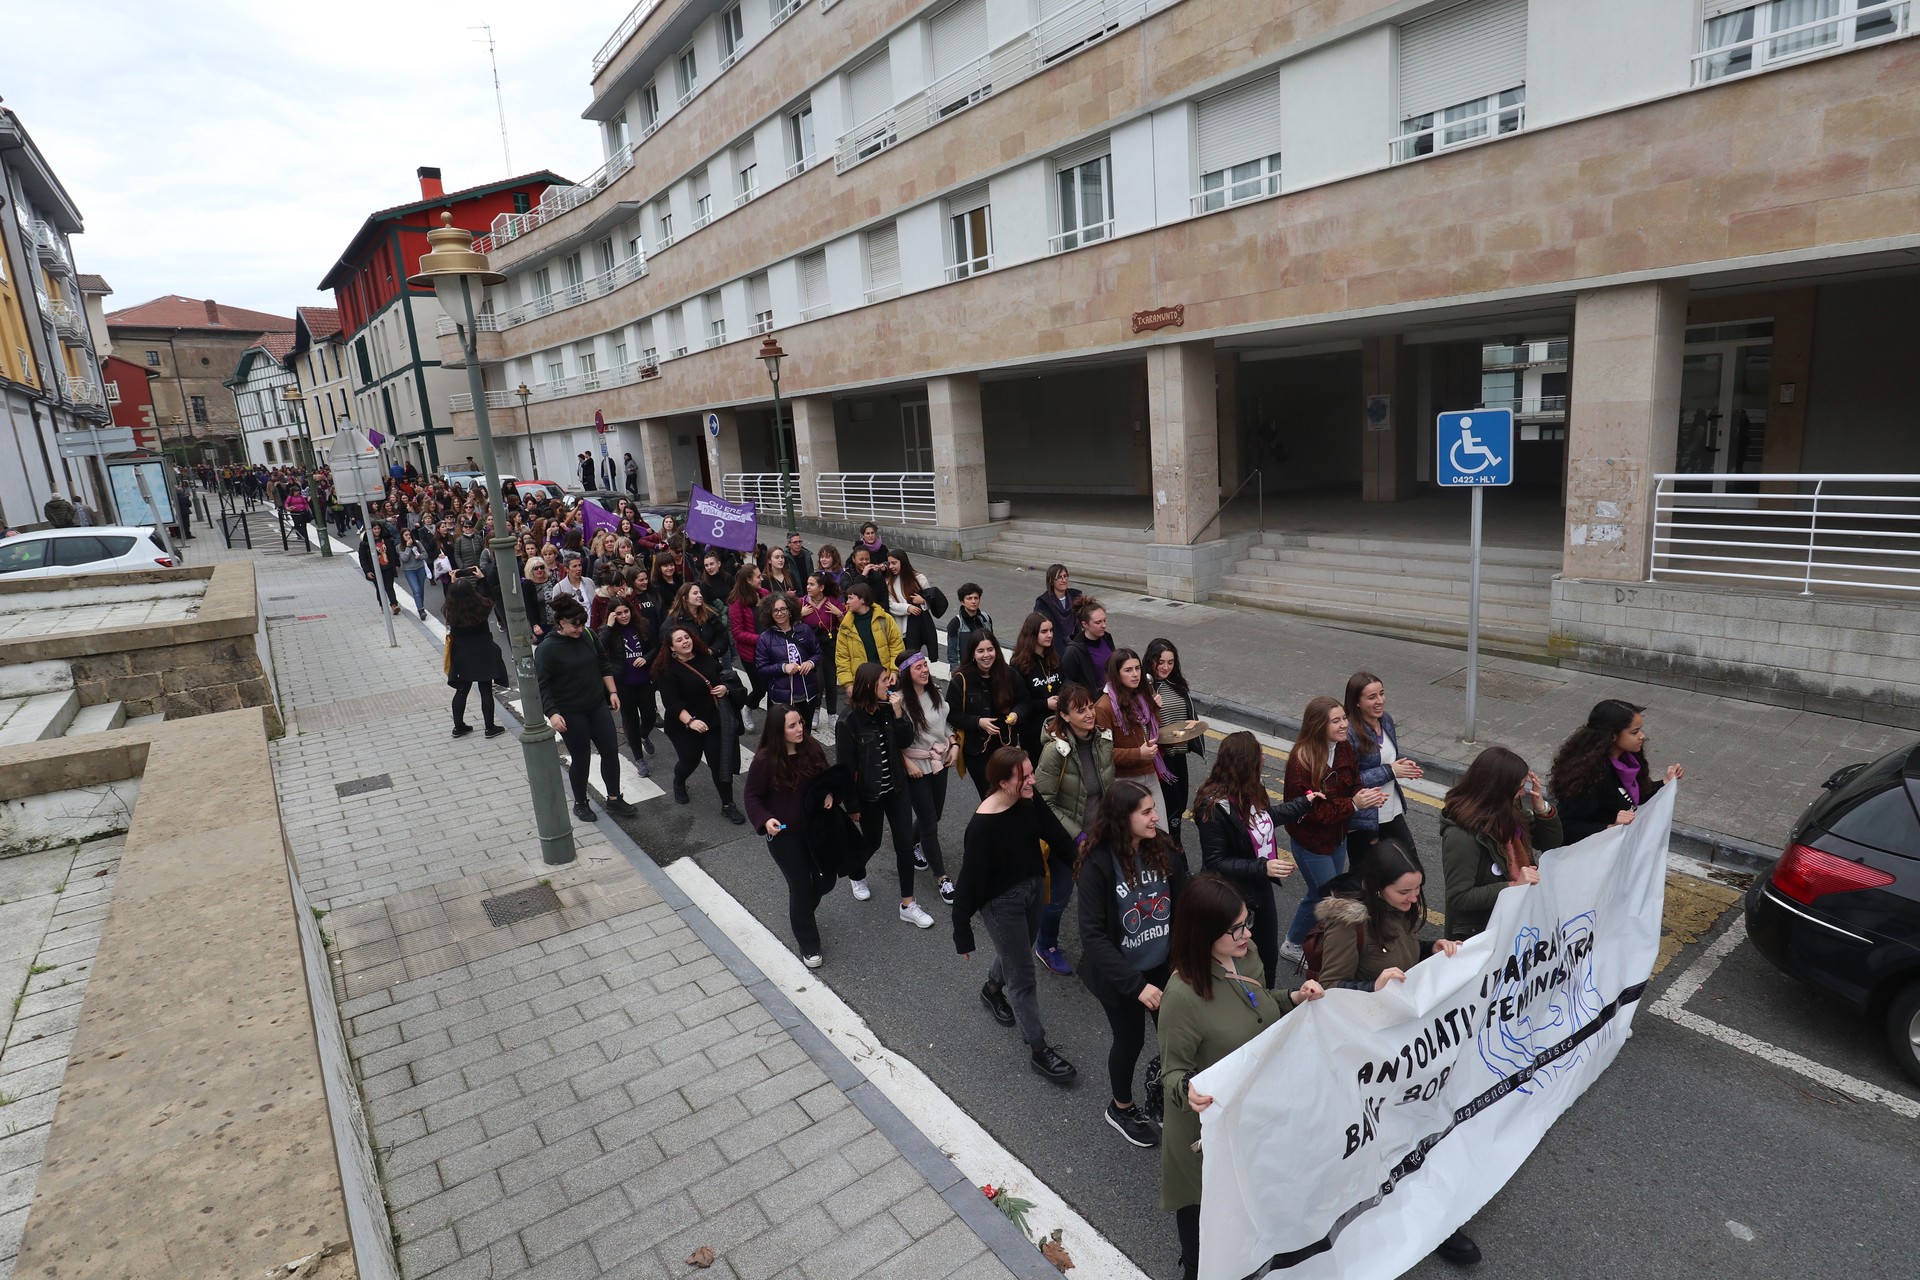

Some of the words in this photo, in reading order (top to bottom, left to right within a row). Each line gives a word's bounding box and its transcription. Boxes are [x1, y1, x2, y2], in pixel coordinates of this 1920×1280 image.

[1452, 476, 1474, 484] 0422
[1480, 475, 1496, 483] HLY
[711, 519, 725, 538] 8
